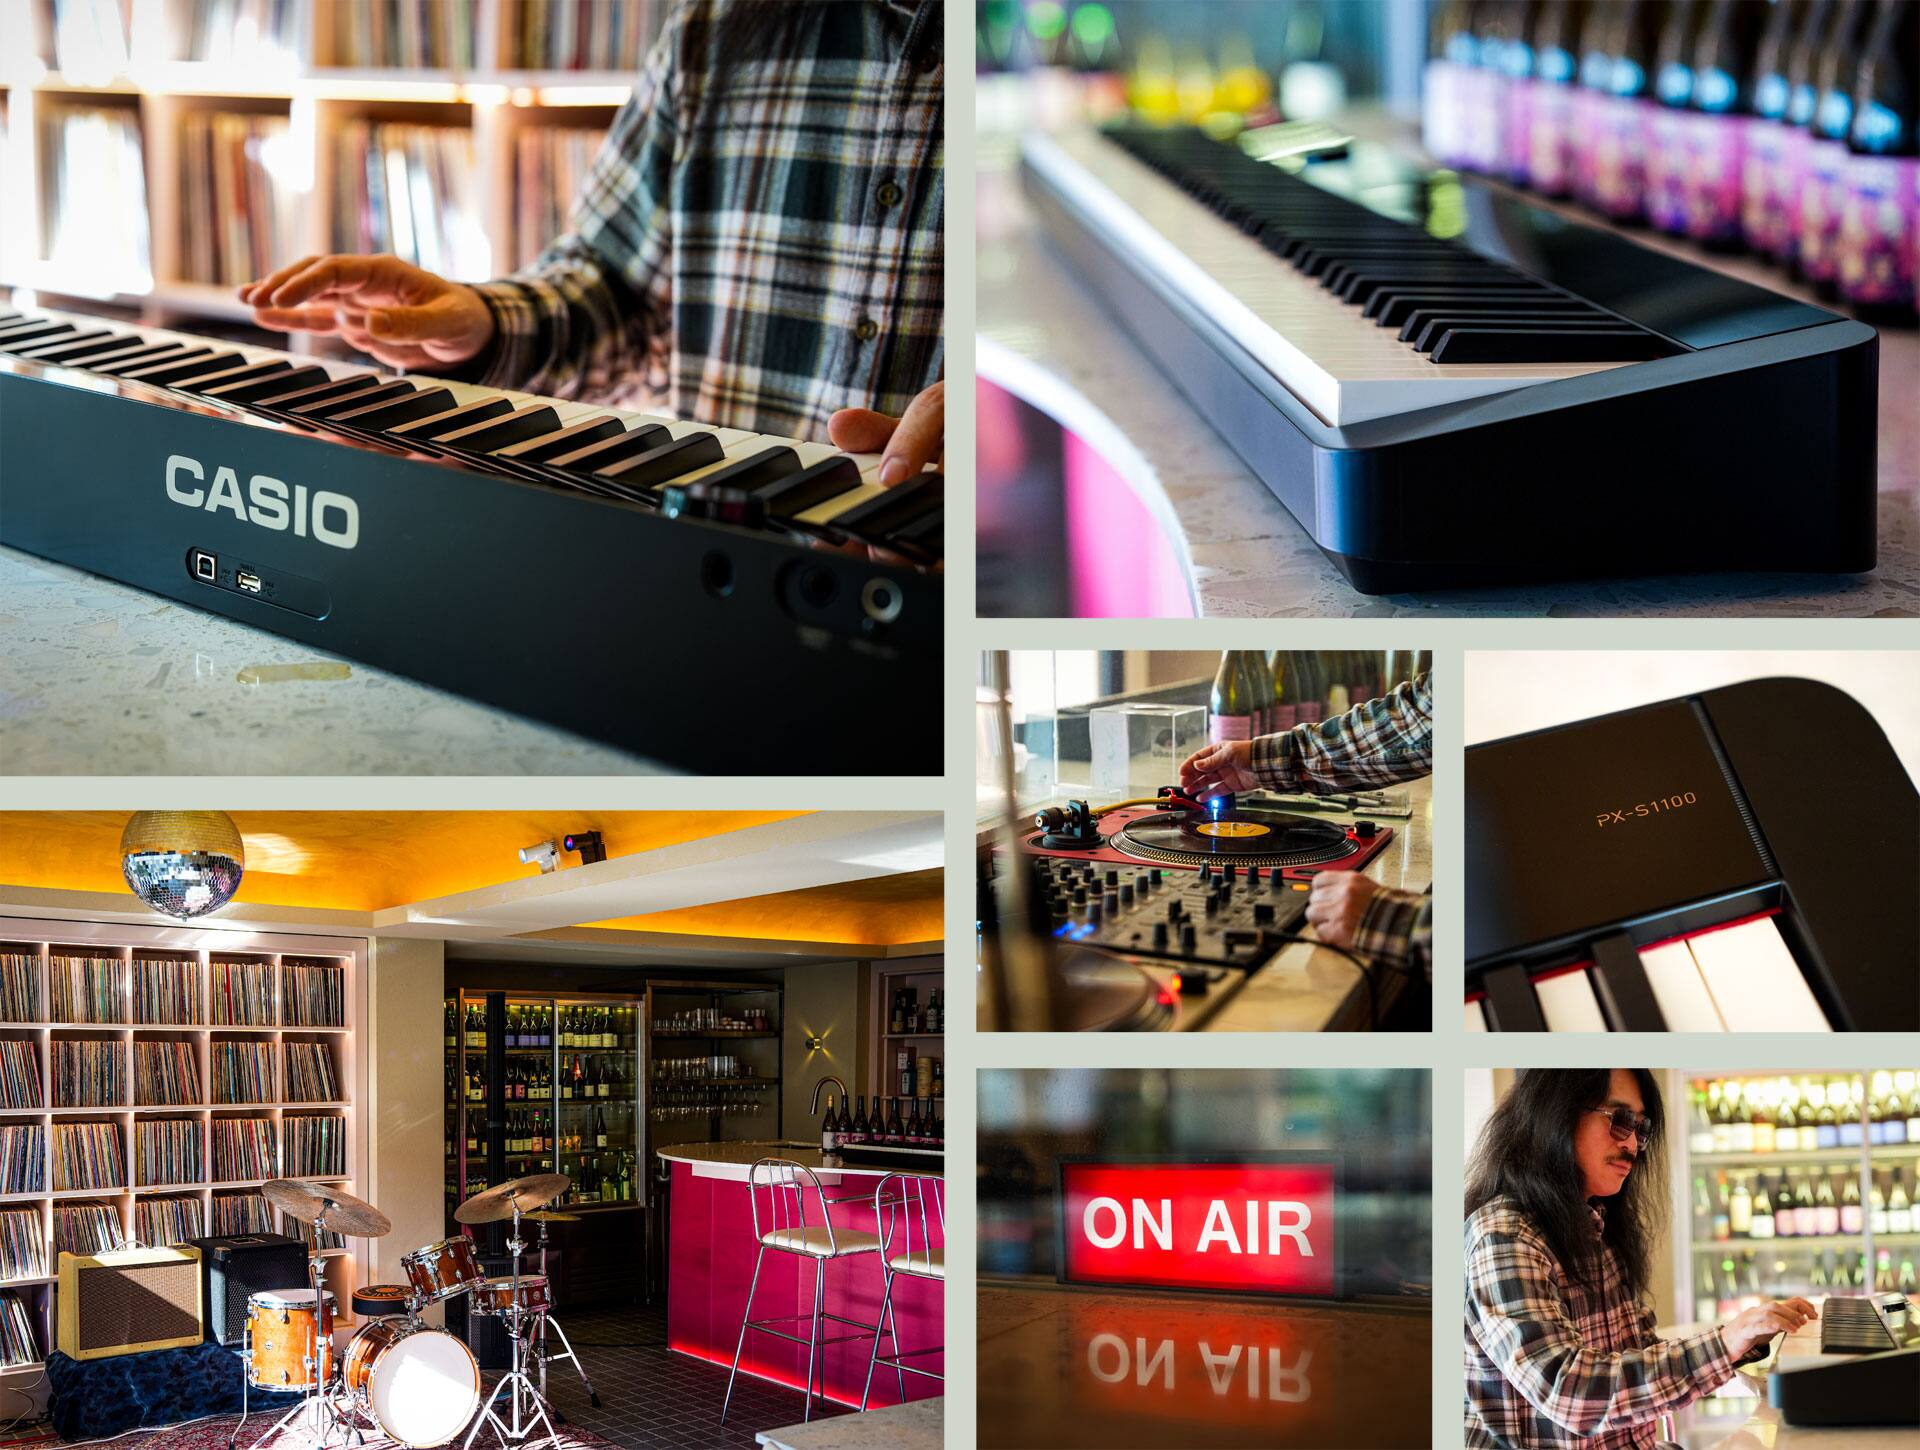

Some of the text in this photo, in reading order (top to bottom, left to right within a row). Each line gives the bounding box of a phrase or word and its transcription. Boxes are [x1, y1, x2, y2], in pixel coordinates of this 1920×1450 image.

[166, 454, 359, 549] CASIO
[1596, 791, 1697, 828] PX-S1100
[1083, 1197, 1314, 1257] ON AIR
